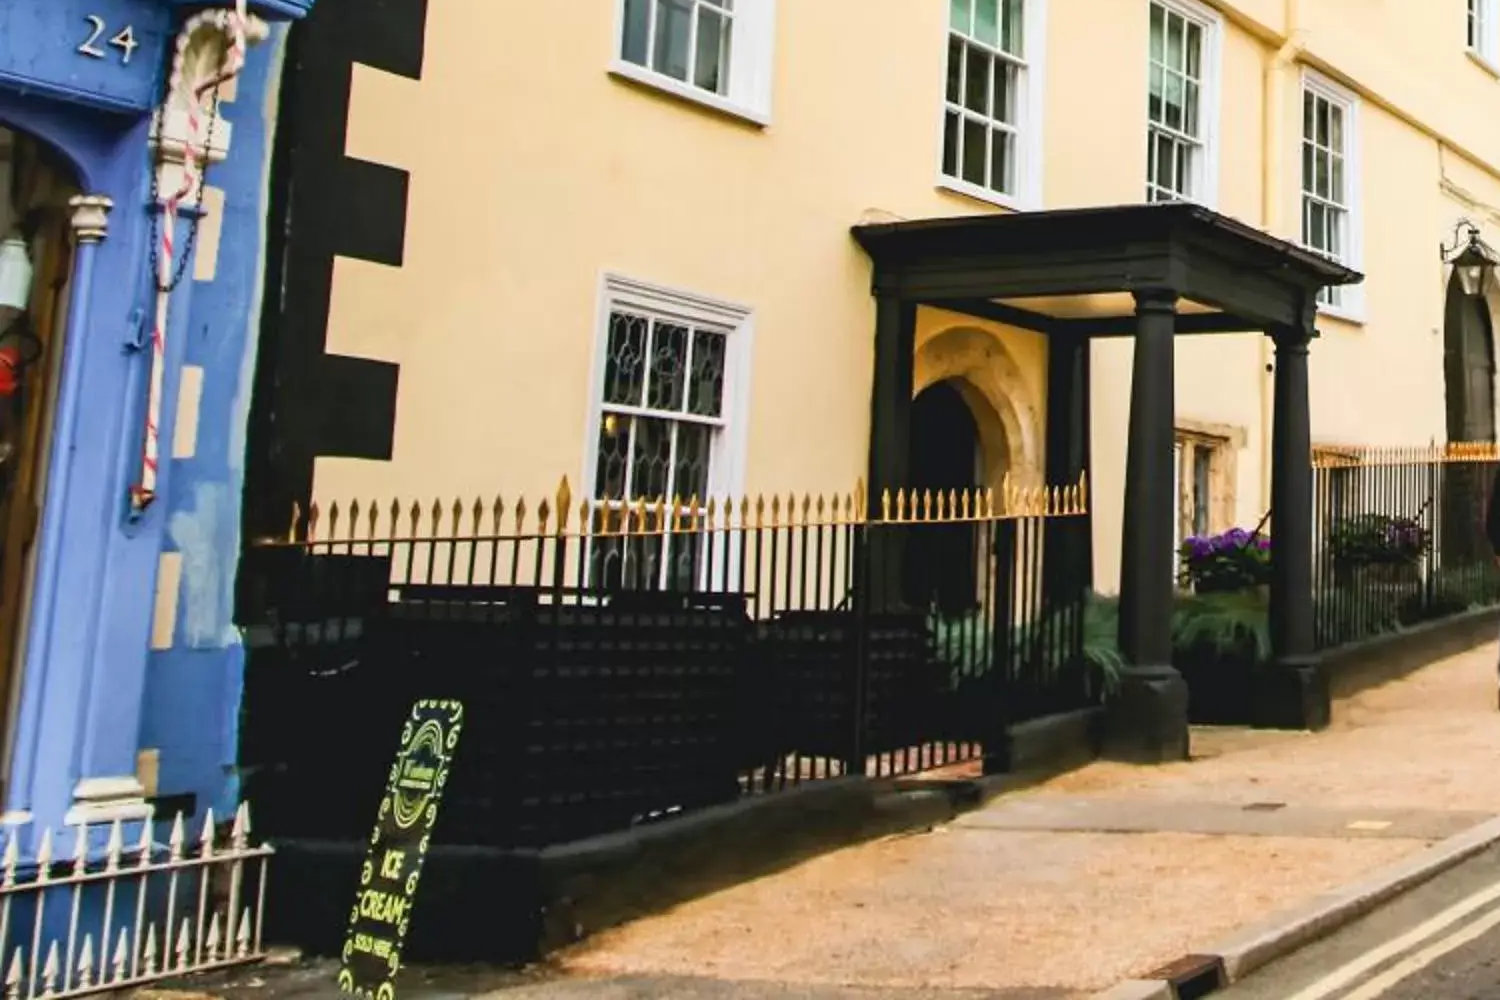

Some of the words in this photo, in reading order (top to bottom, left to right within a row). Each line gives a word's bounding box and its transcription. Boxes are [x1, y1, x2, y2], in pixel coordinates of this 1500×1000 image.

[79, 14, 138, 63] 24
[380, 849, 405, 880] ICE
[361, 889, 406, 925] CREAM
